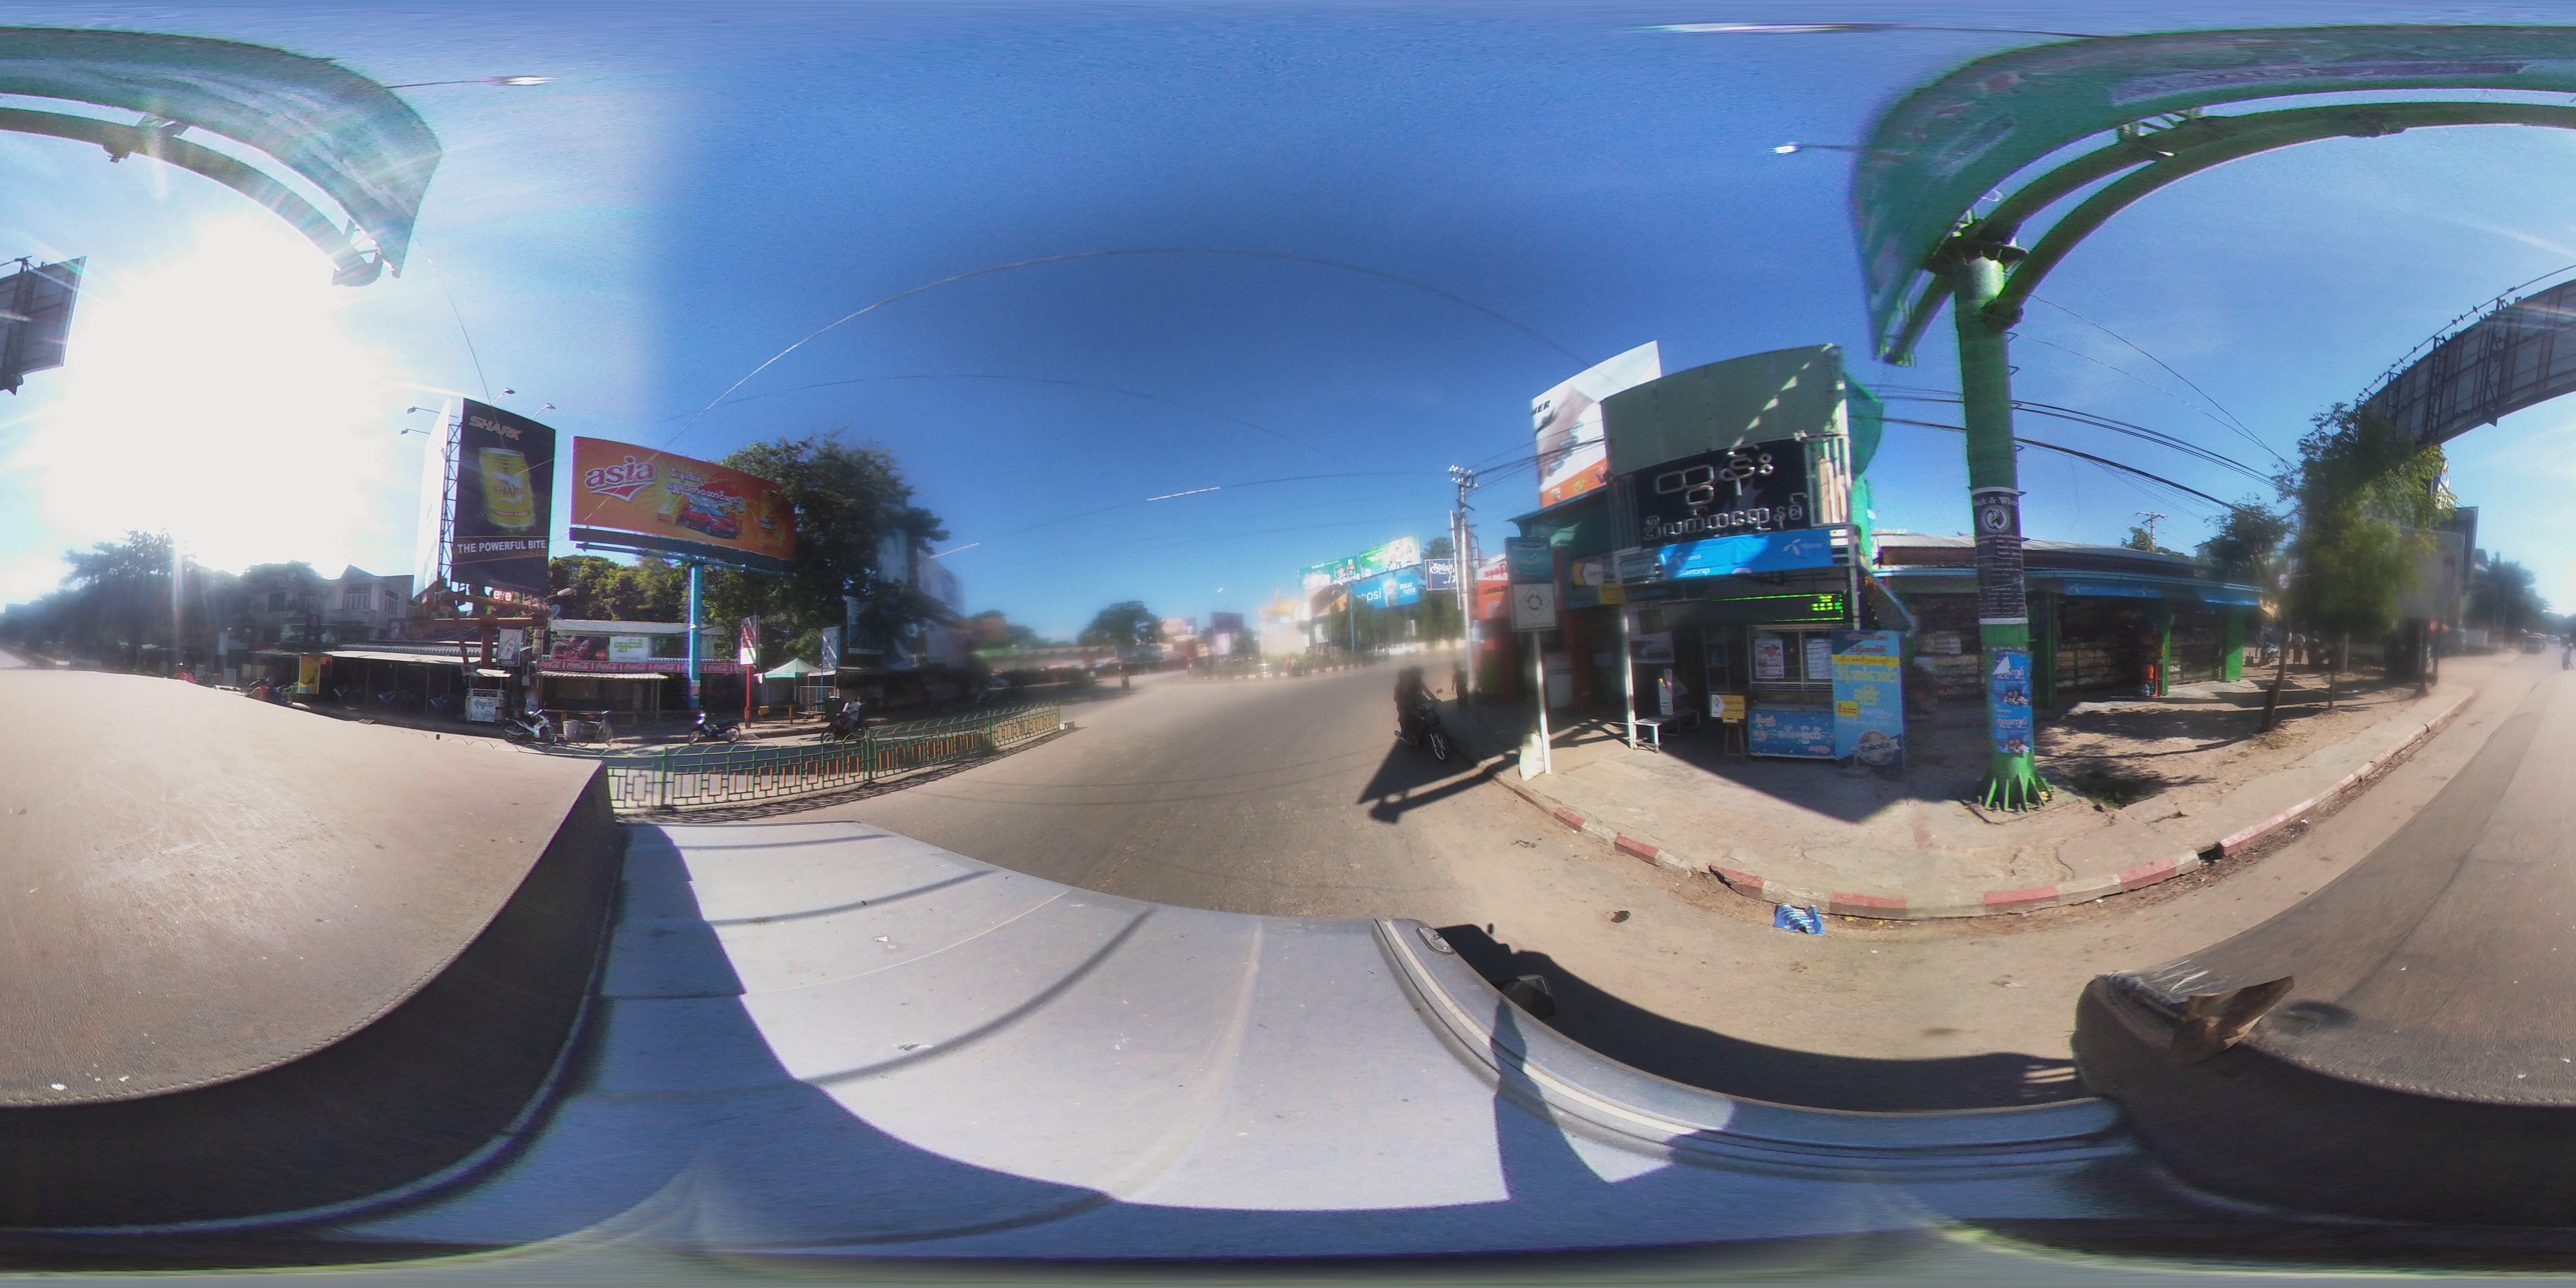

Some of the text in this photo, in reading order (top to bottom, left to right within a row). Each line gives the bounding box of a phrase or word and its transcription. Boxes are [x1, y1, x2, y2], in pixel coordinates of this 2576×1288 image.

[468, 416, 522, 441] SHARK
[584, 456, 656, 489] asia
[492, 485, 524, 496] SHARK
[457, 540, 546, 553] THE POWERFUL BITE
[1358, 587, 1382, 604] psi
